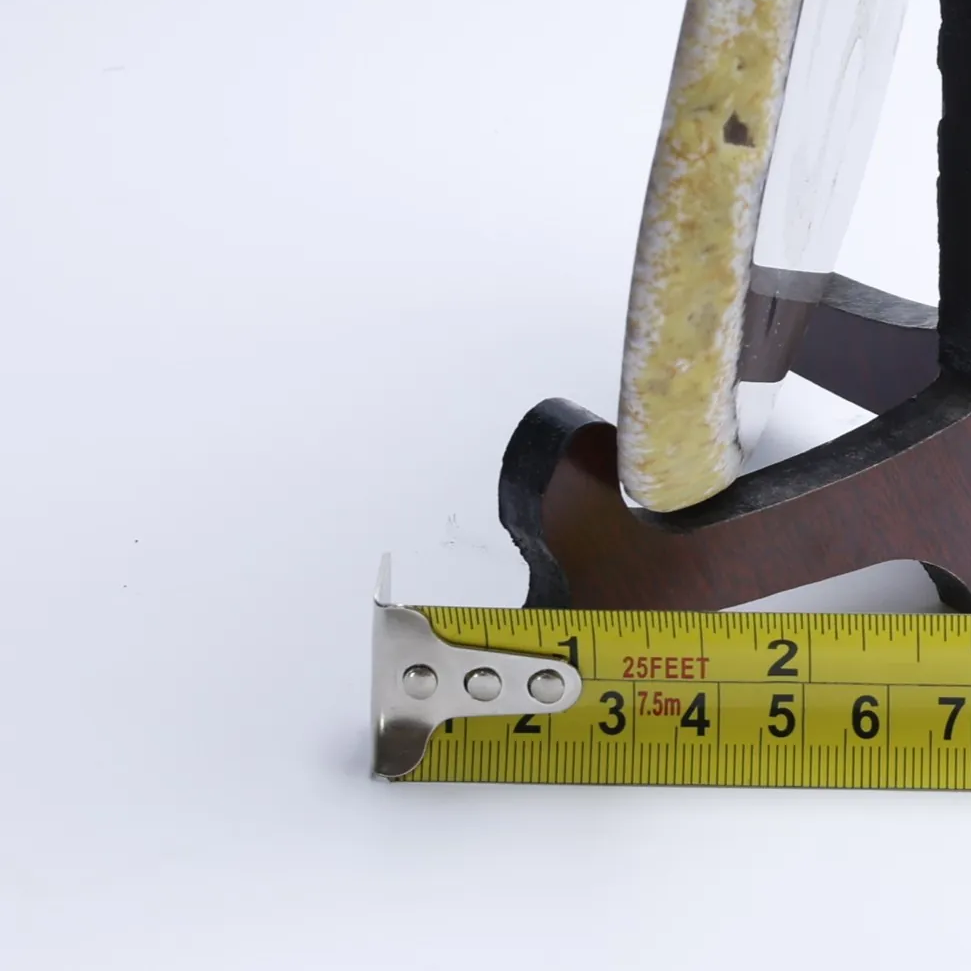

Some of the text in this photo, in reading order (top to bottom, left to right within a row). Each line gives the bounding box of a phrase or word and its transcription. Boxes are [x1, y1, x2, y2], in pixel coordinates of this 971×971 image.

[557, 636, 579, 670] 1
[767, 640, 799, 677] 2
[622, 657, 709, 679] 25FEET
[598, 691, 627, 735] 3
[680, 693, 710, 737] 4
[768, 693, 796, 738] 5
[851, 695, 880, 739] 6
[937, 697, 966, 741] 7
[637, 691, 681, 717] 7.5m
